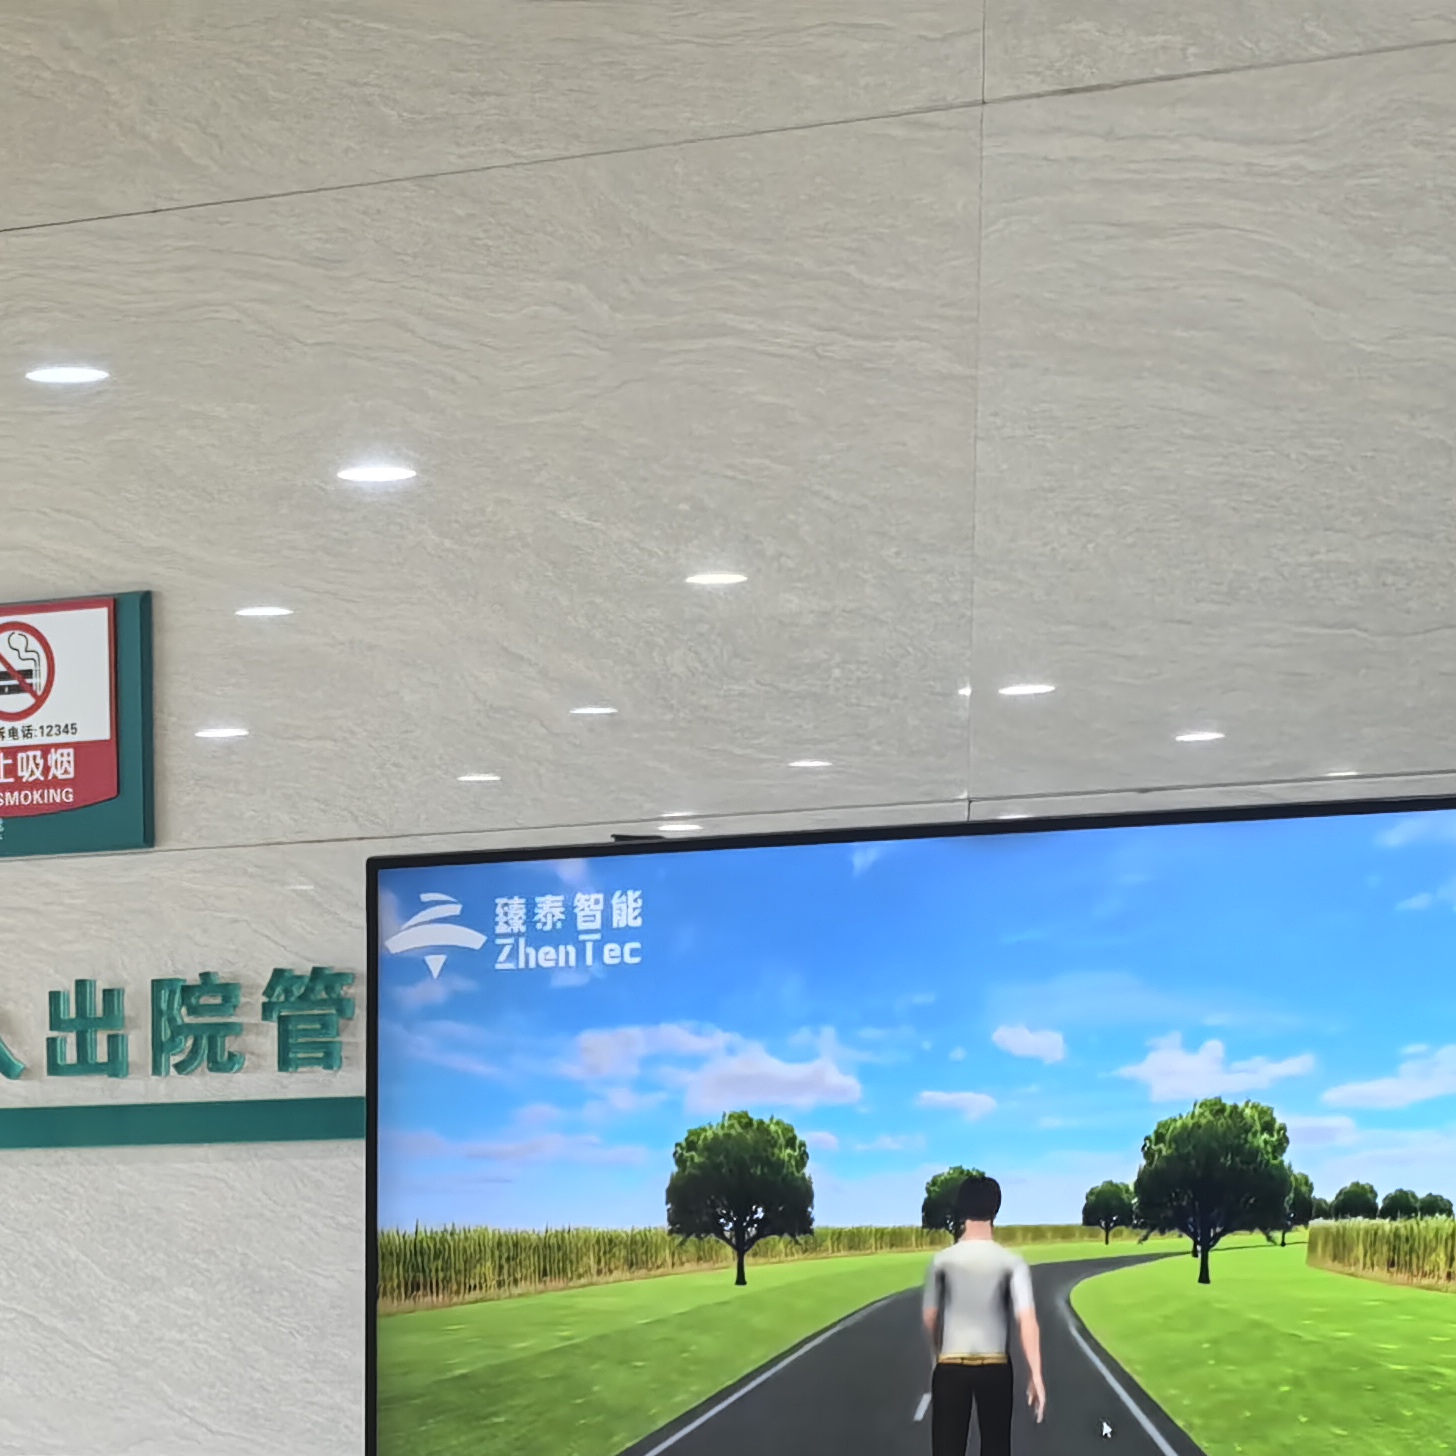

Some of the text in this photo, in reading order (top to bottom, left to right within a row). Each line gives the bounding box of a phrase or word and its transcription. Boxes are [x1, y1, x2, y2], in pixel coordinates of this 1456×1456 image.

[494, 890, 643, 934] 臻泰智能
[494, 933, 642, 970] ZhenTec
